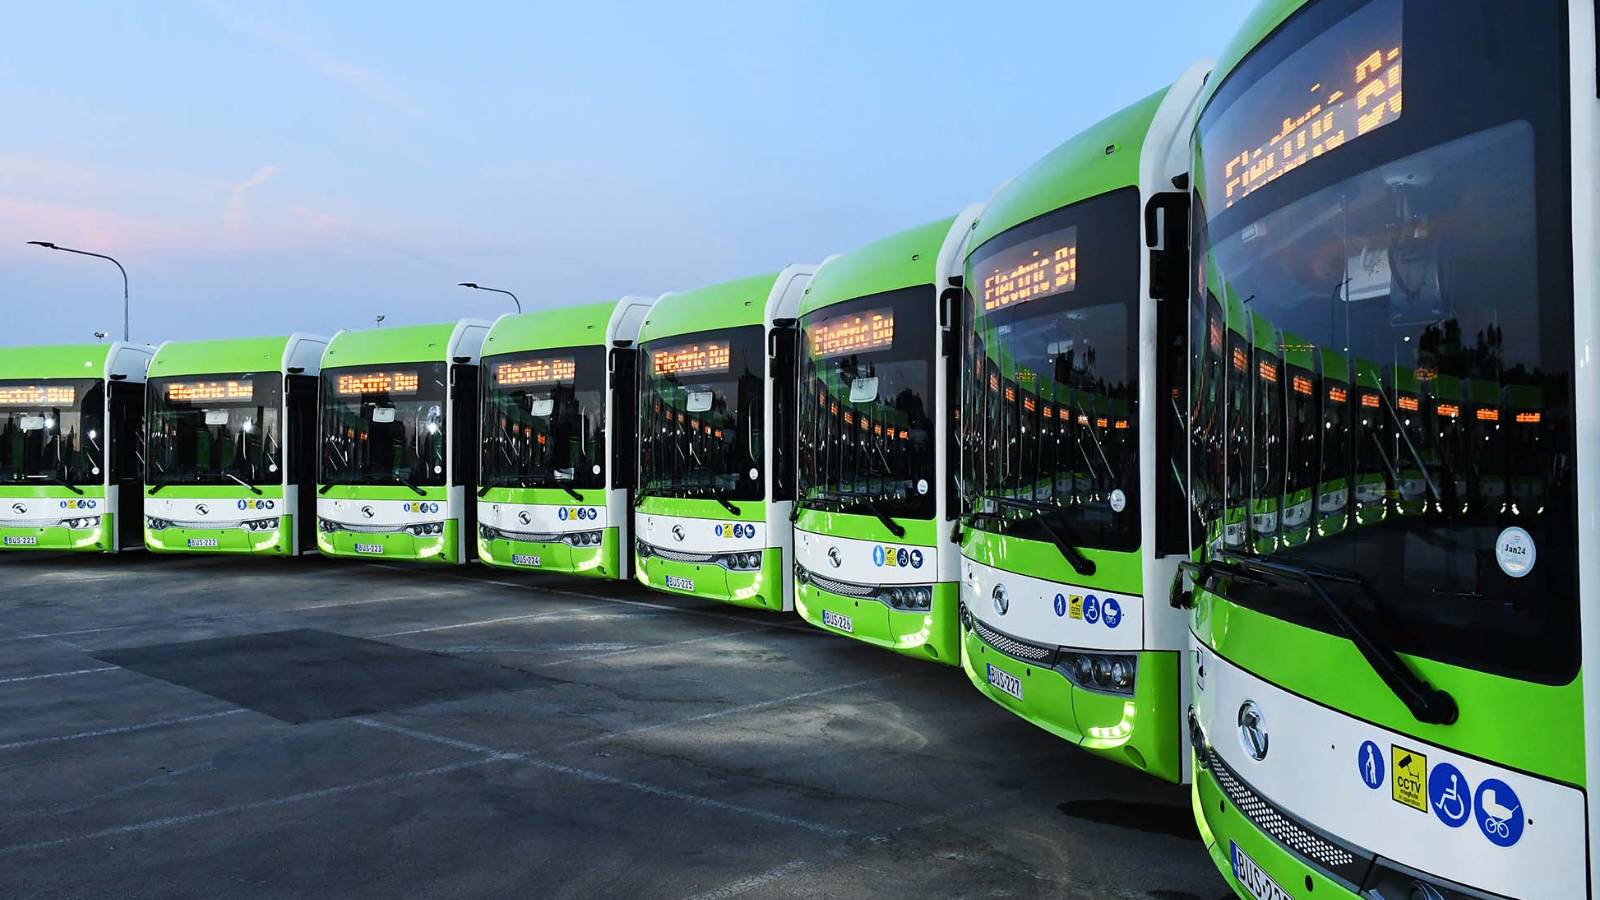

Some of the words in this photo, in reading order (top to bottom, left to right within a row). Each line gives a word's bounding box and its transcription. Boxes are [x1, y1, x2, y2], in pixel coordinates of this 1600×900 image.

[814, 318, 869, 355] Electric
[655, 346, 706, 374] Electric
[339, 372, 391, 393] Electric
[499, 361, 550, 384] Electric
[169, 383, 225, 399] Electric
[1397, 776, 1421, 793] CCTV
[1238, 851, 1294, 900] BUS-2
